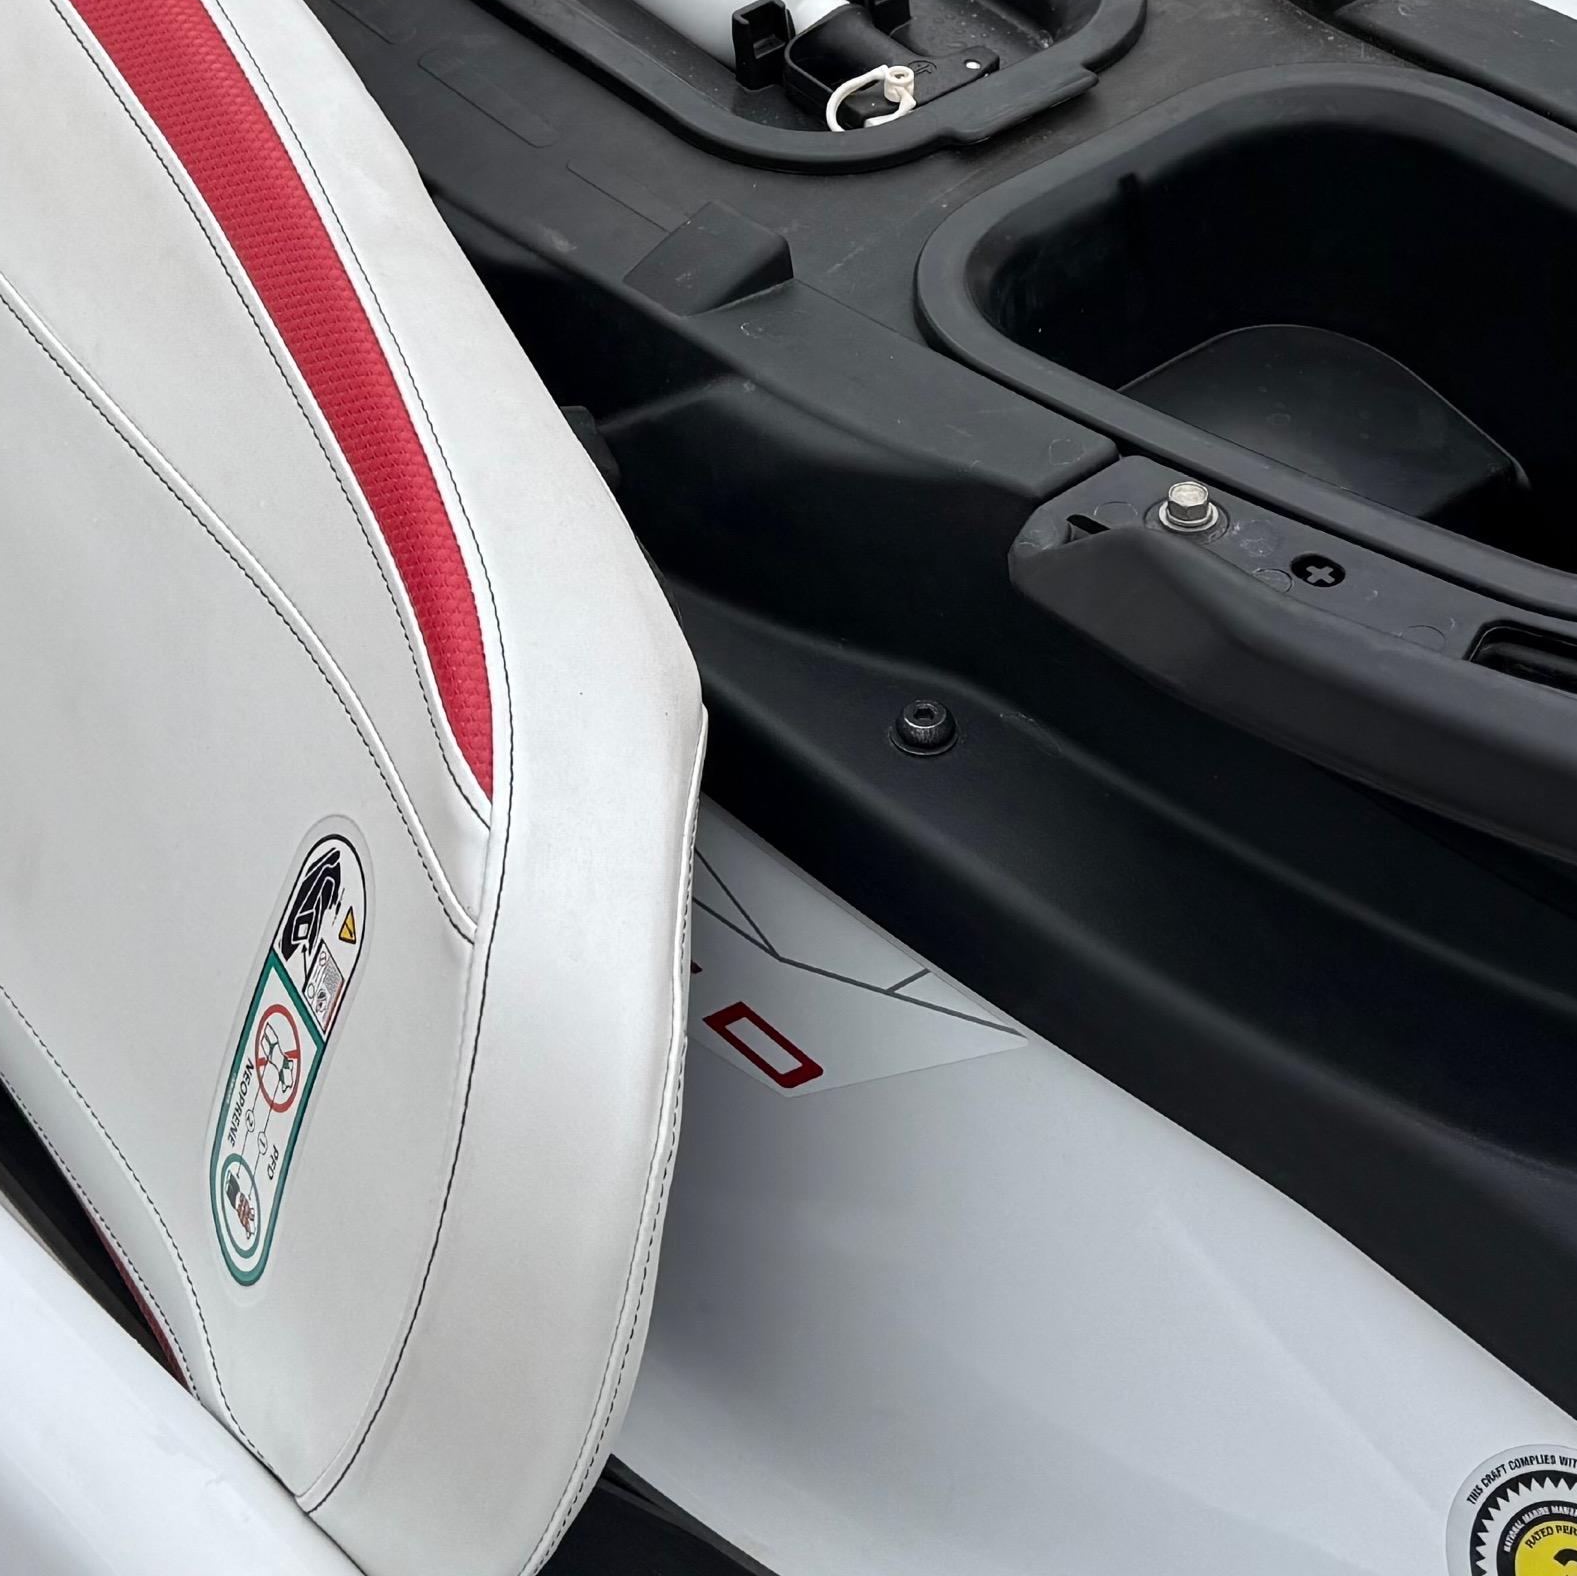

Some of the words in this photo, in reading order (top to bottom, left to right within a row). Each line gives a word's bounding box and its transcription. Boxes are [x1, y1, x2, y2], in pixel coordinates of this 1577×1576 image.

[227, 1057, 255, 1148] NEOPRENE
[267, 1144, 279, 1181] PFD
[1466, 1484, 1484, 1505] THIS
[1480, 1463, 1508, 1488] CRAFT
[1508, 1454, 1557, 1471] COMPLIES
[1525, 1526, 1554, 1550] RATED
